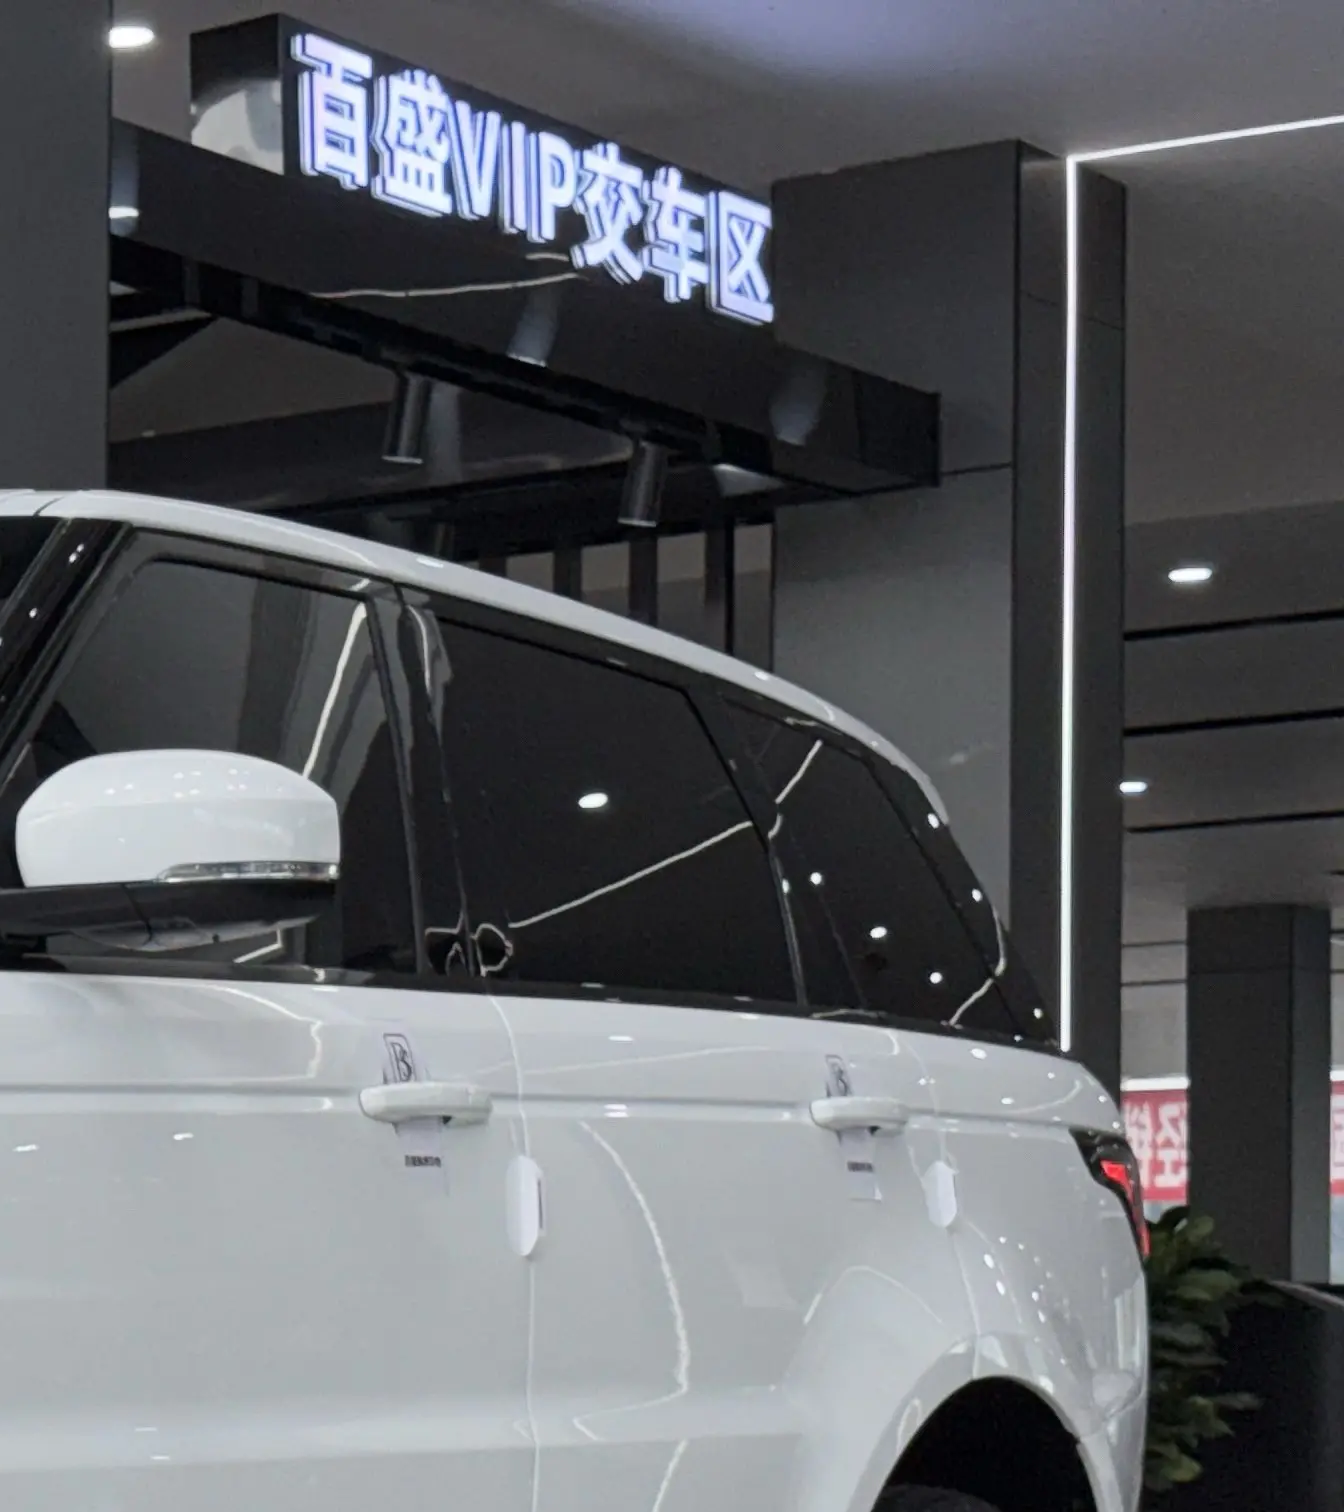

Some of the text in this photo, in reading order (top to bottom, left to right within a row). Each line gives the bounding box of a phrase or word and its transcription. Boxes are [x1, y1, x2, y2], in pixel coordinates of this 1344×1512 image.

[291, 32, 774, 324] 百盛VIP交车区
